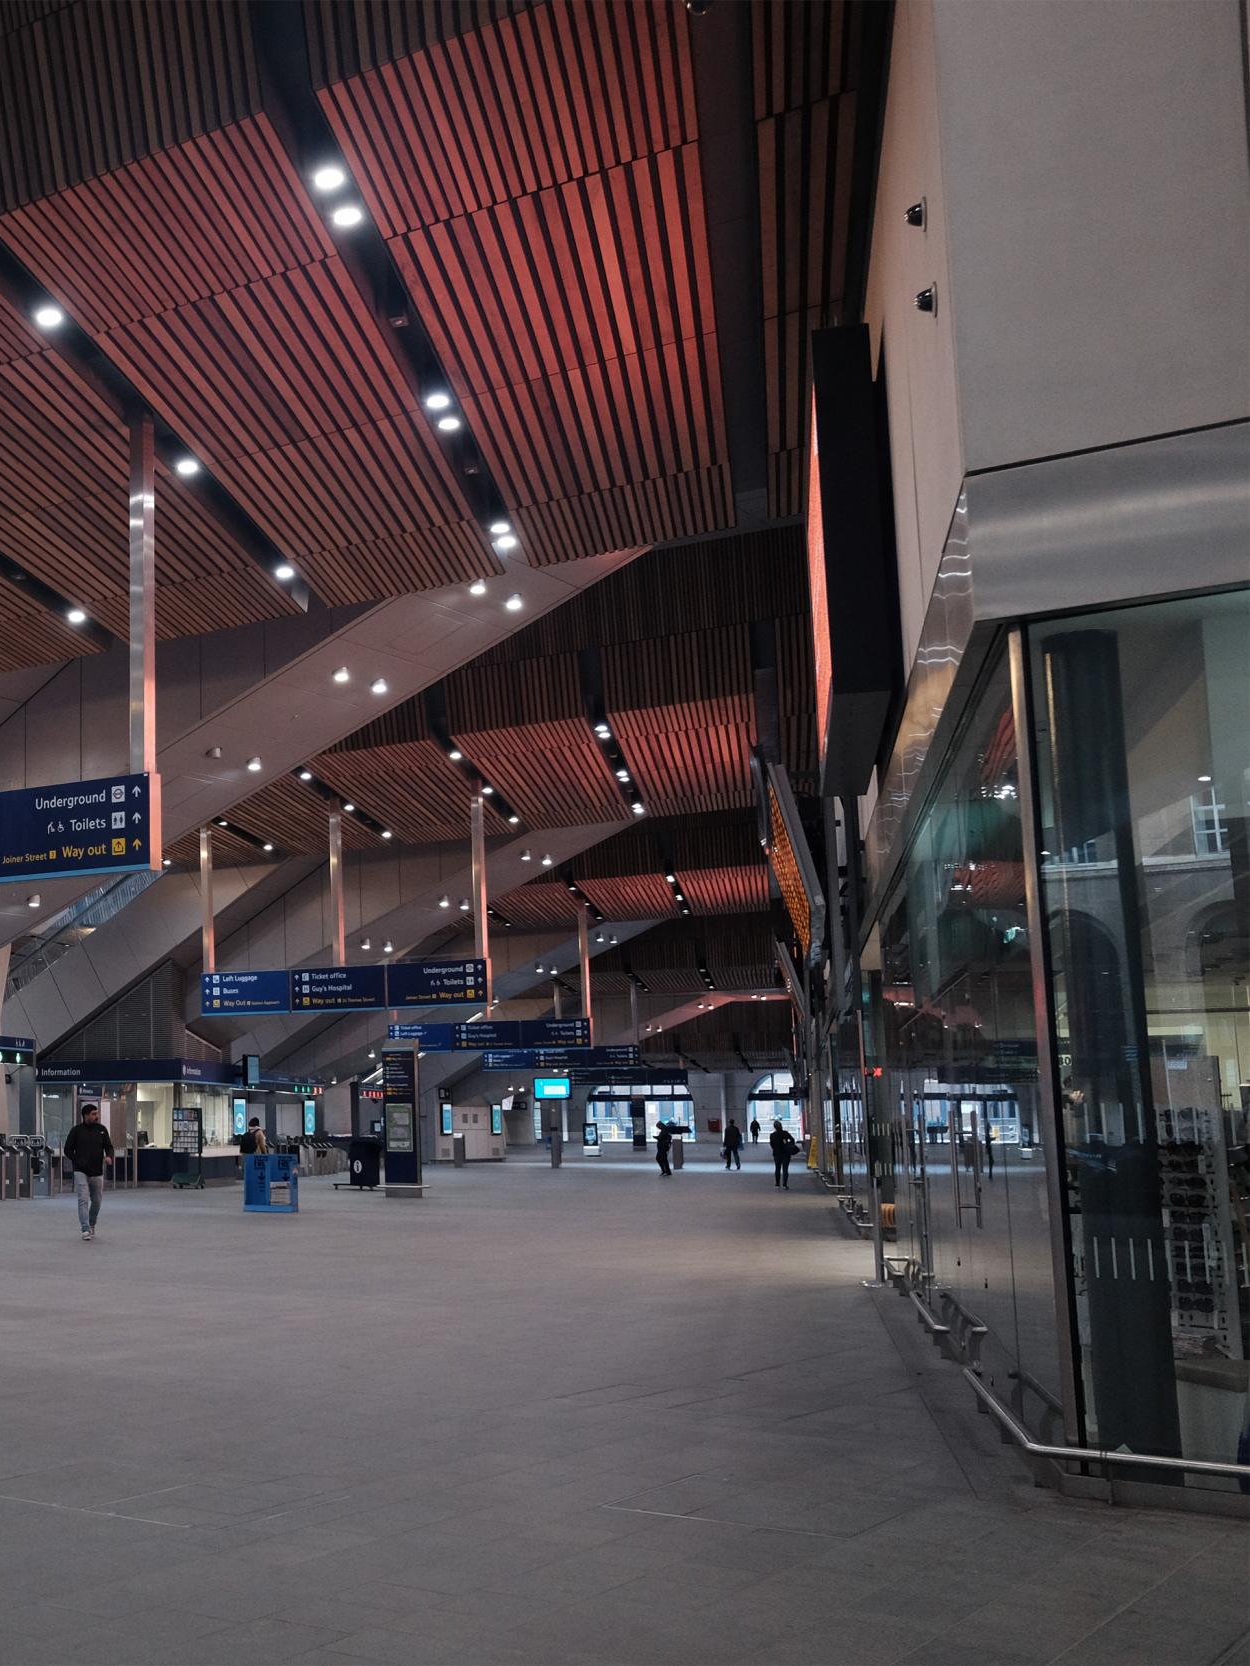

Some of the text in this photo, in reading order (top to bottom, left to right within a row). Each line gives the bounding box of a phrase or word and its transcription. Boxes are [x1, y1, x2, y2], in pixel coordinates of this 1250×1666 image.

[35, 789, 106, 810] Underground
[70, 817, 107, 832] Toilets
[2, 854, 23, 865] Joiner
[25, 852, 47, 862] Street
[61, 846, 85, 860] Way
[87, 843, 107, 856] out
[423, 965, 463, 974] Underground
[222, 975, 258, 983] Left Luggage
[311, 984, 352, 993] Guy's Hospital
[439, 991, 452, 999] Way
[223, 1000, 235, 1008] Way
[41, 1068, 81, 1076] Information
